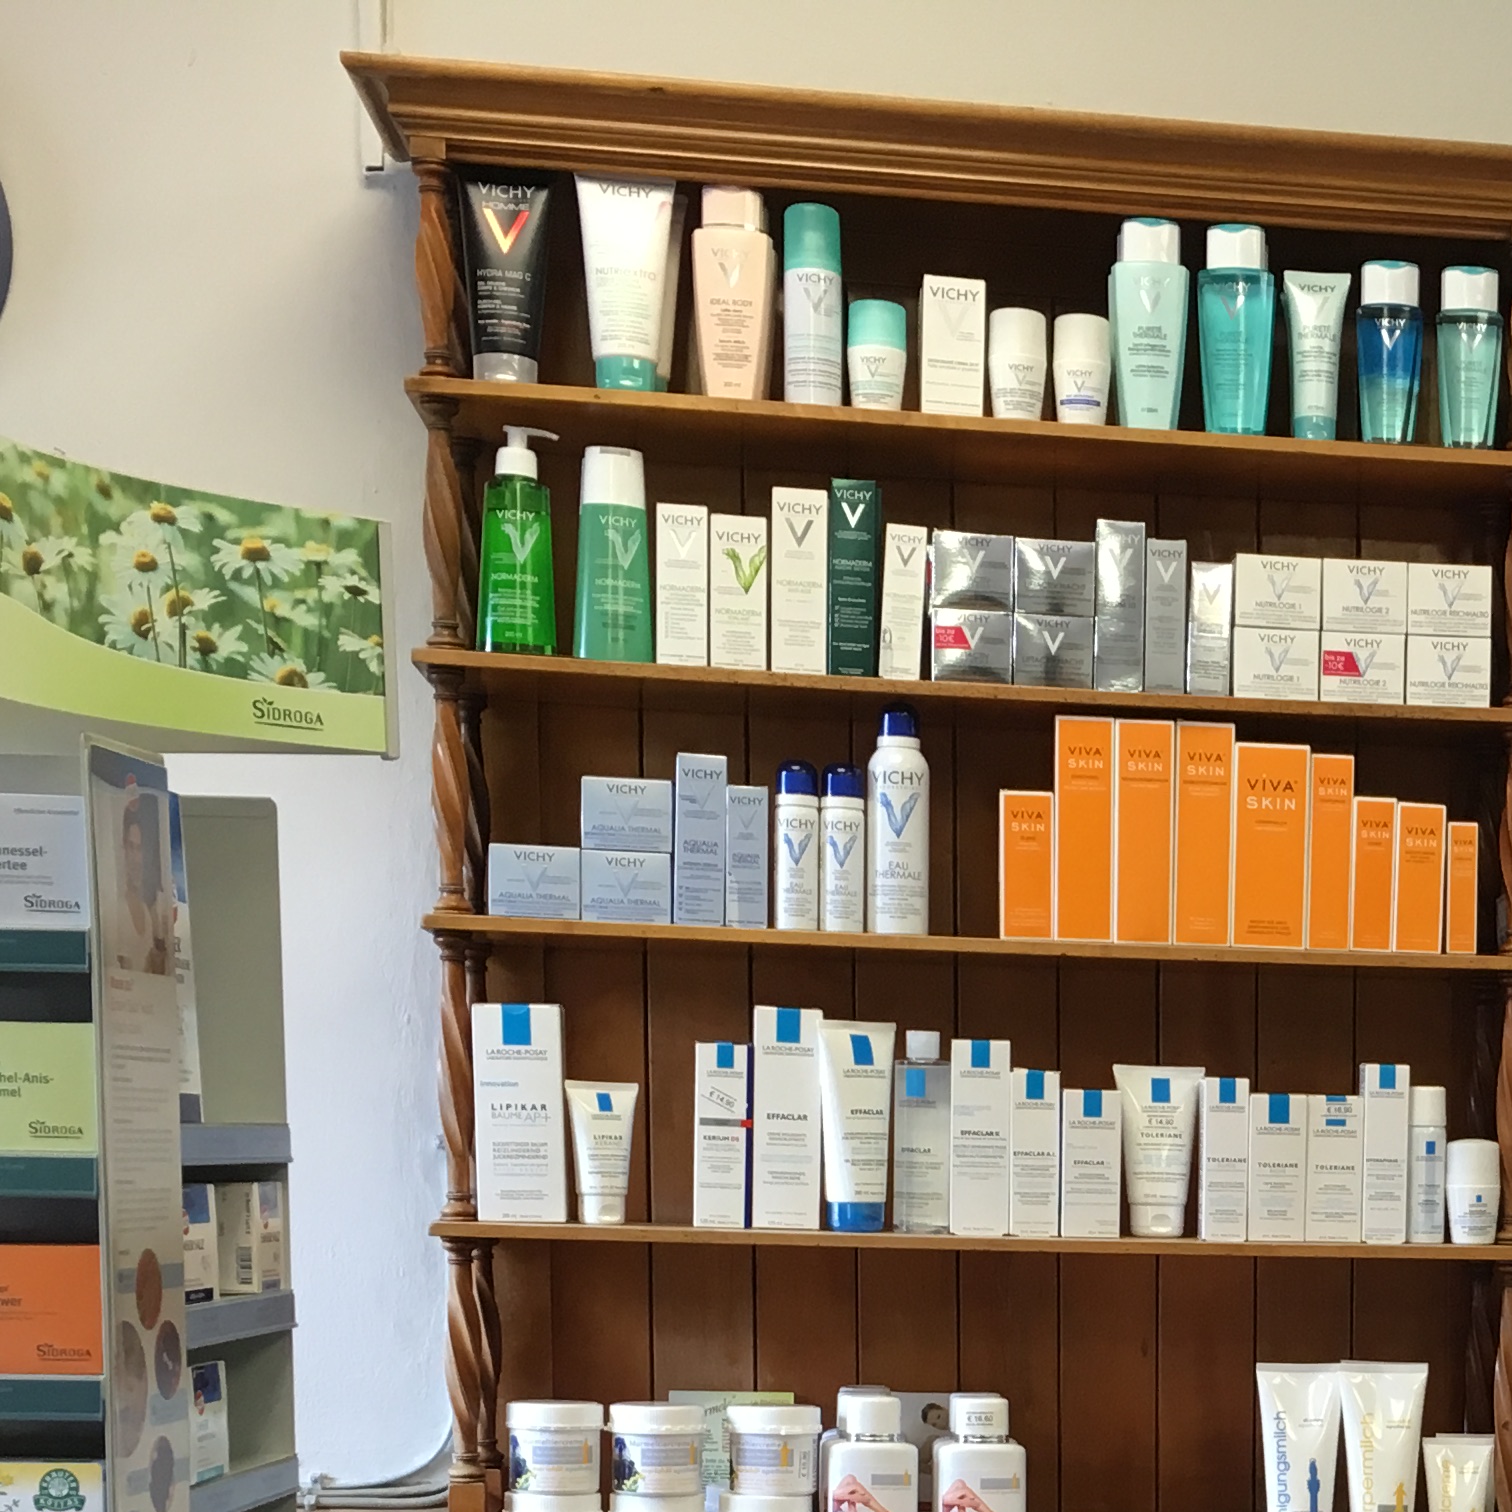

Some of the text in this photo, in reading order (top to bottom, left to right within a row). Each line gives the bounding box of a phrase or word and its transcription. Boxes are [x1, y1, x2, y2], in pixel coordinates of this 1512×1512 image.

[478, 182, 535, 198] VICHY
[600, 184, 654, 199] VICHY
[482, 201, 529, 210] HOMME
[797, 273, 834, 285] VICHY
[929, 286, 979, 302] VICHY
[835, 489, 872, 500] VICHY
[777, 501, 822, 515] VICHY
[662, 514, 703, 526] VICHY
[716, 531, 761, 544] VICHY
[1261, 561, 1298, 571] VICHY
[1348, 565, 1385, 576] VICHY
[1432, 569, 1469, 579] VICHY
[1258, 633, 1296, 644] VICHY
[1345, 638, 1383, 648] VICHY
[1432, 641, 1468, 651] VICHY
[252, 698, 324, 726] SIDROGA
[1068, 759, 1103, 769] SKIN
[1127, 760, 1163, 773] SKIN
[682, 769, 722, 780] VICHY
[1186, 764, 1225, 777] SKIN
[606, 784, 646, 795] VICHY
[1318, 786, 1348, 796] SKIN
[1246, 796, 1296, 811] SKIN
[1012, 822, 1045, 832] SKIN
[1361, 829, 1389, 839] SKIN
[1406, 837, 1437, 847] SKIN
[514, 850, 555, 861] VICHY
[605, 857, 645, 867] VICHY
[888, 861, 909, 871] EAU
[875, 870, 922, 881] THERMALE
[24, 894, 80, 910] SIDROGA
[492, 1103, 547, 1111] LIPIKAR
[767, 1113, 808, 1122] EFFACLAR
[29, 1120, 83, 1136] SIDROGA
[37, 1344, 91, 1358] SIDROGA
